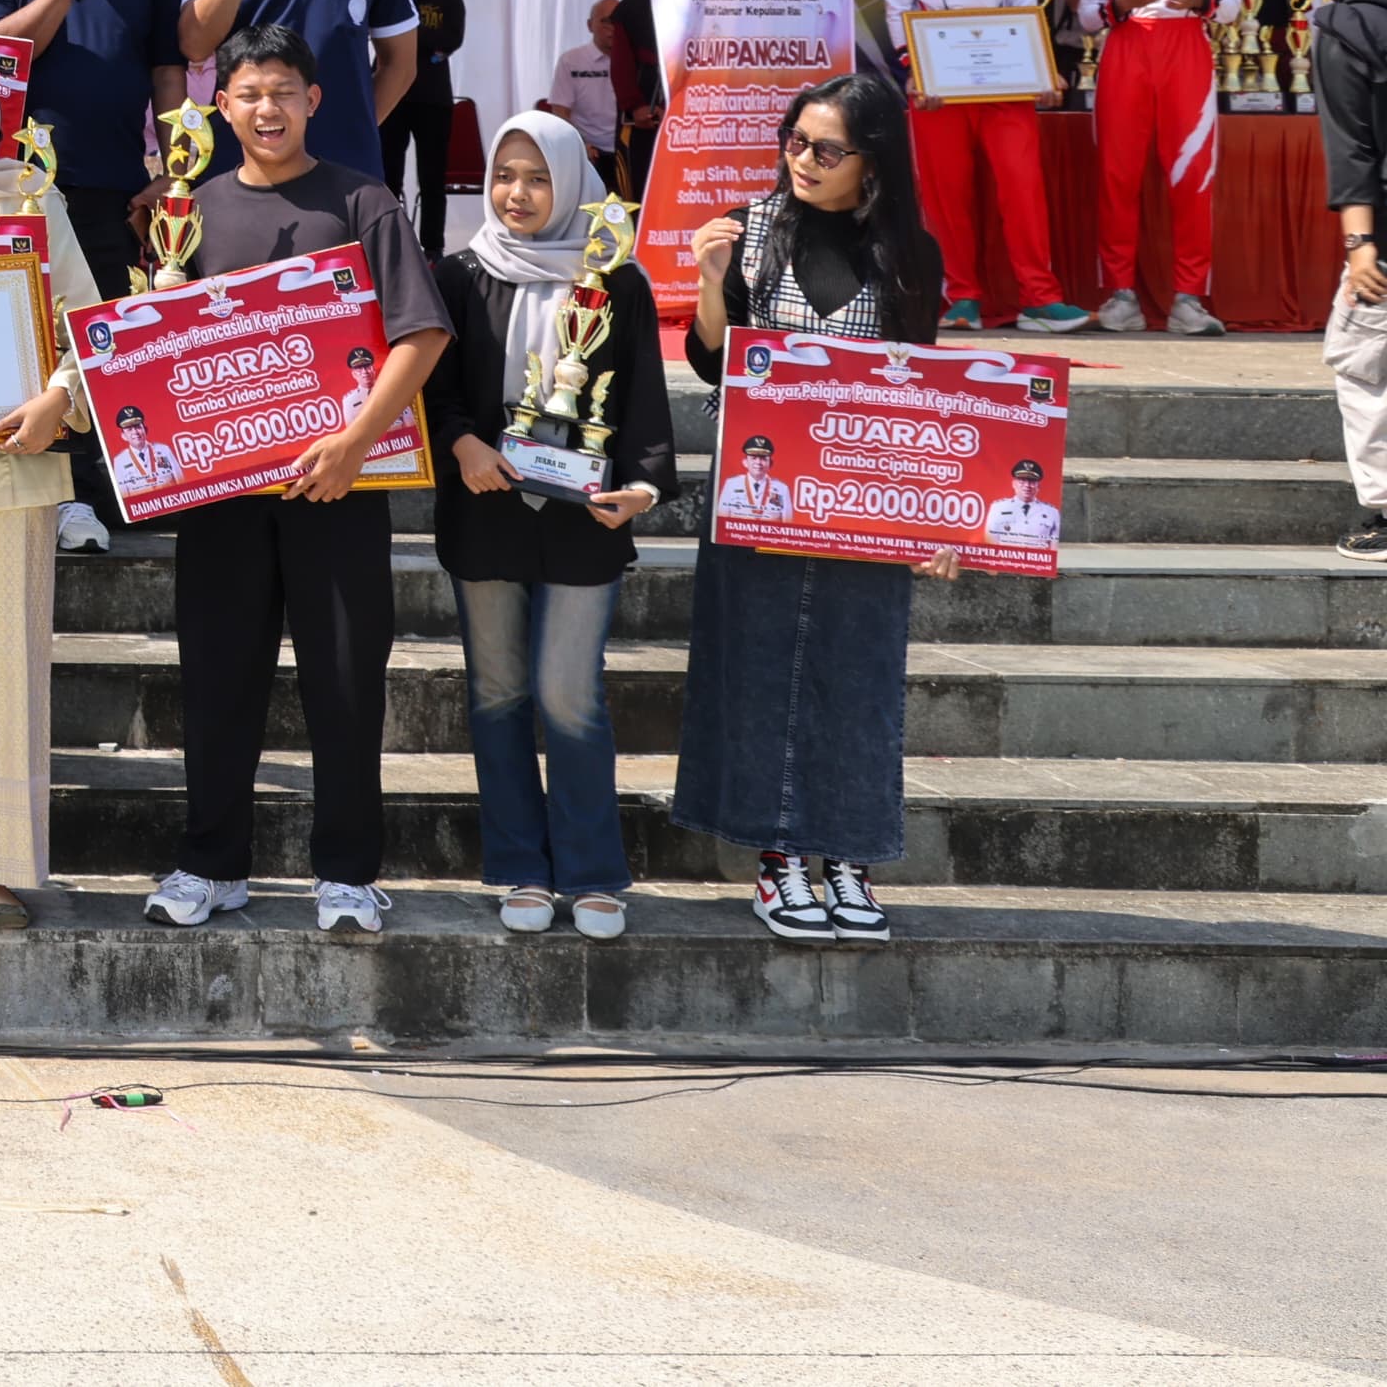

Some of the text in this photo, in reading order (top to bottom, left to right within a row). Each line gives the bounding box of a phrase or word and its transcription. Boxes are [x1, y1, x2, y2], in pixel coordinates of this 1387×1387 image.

[687, 40, 828, 66] SALAM PANCASILA
[717, 189, 722, 203] 1
[103, 304, 359, 375] Gebyar Pelajar Pancasila Kepri Tahun 2025
[171, 340, 309, 390] JUARA 3
[181, 376, 315, 421] Lomba Video Pendek
[749, 384, 1045, 425] Gebyar Pelajar Pancasila Kepri Tahun 2025
[815, 417, 975, 452] JUARA 3
[130, 436, 413, 516] BADAN KESATUAN BANGSA DAN RIAU
[825, 452, 957, 482] Lomba Cipta Lagu
[799, 482, 981, 526] Rp.2.000.000
[726, 522, 1051, 563] BADAN KESATUAN BANGSA DAN POLITIK KEPULAUAN RIAU
